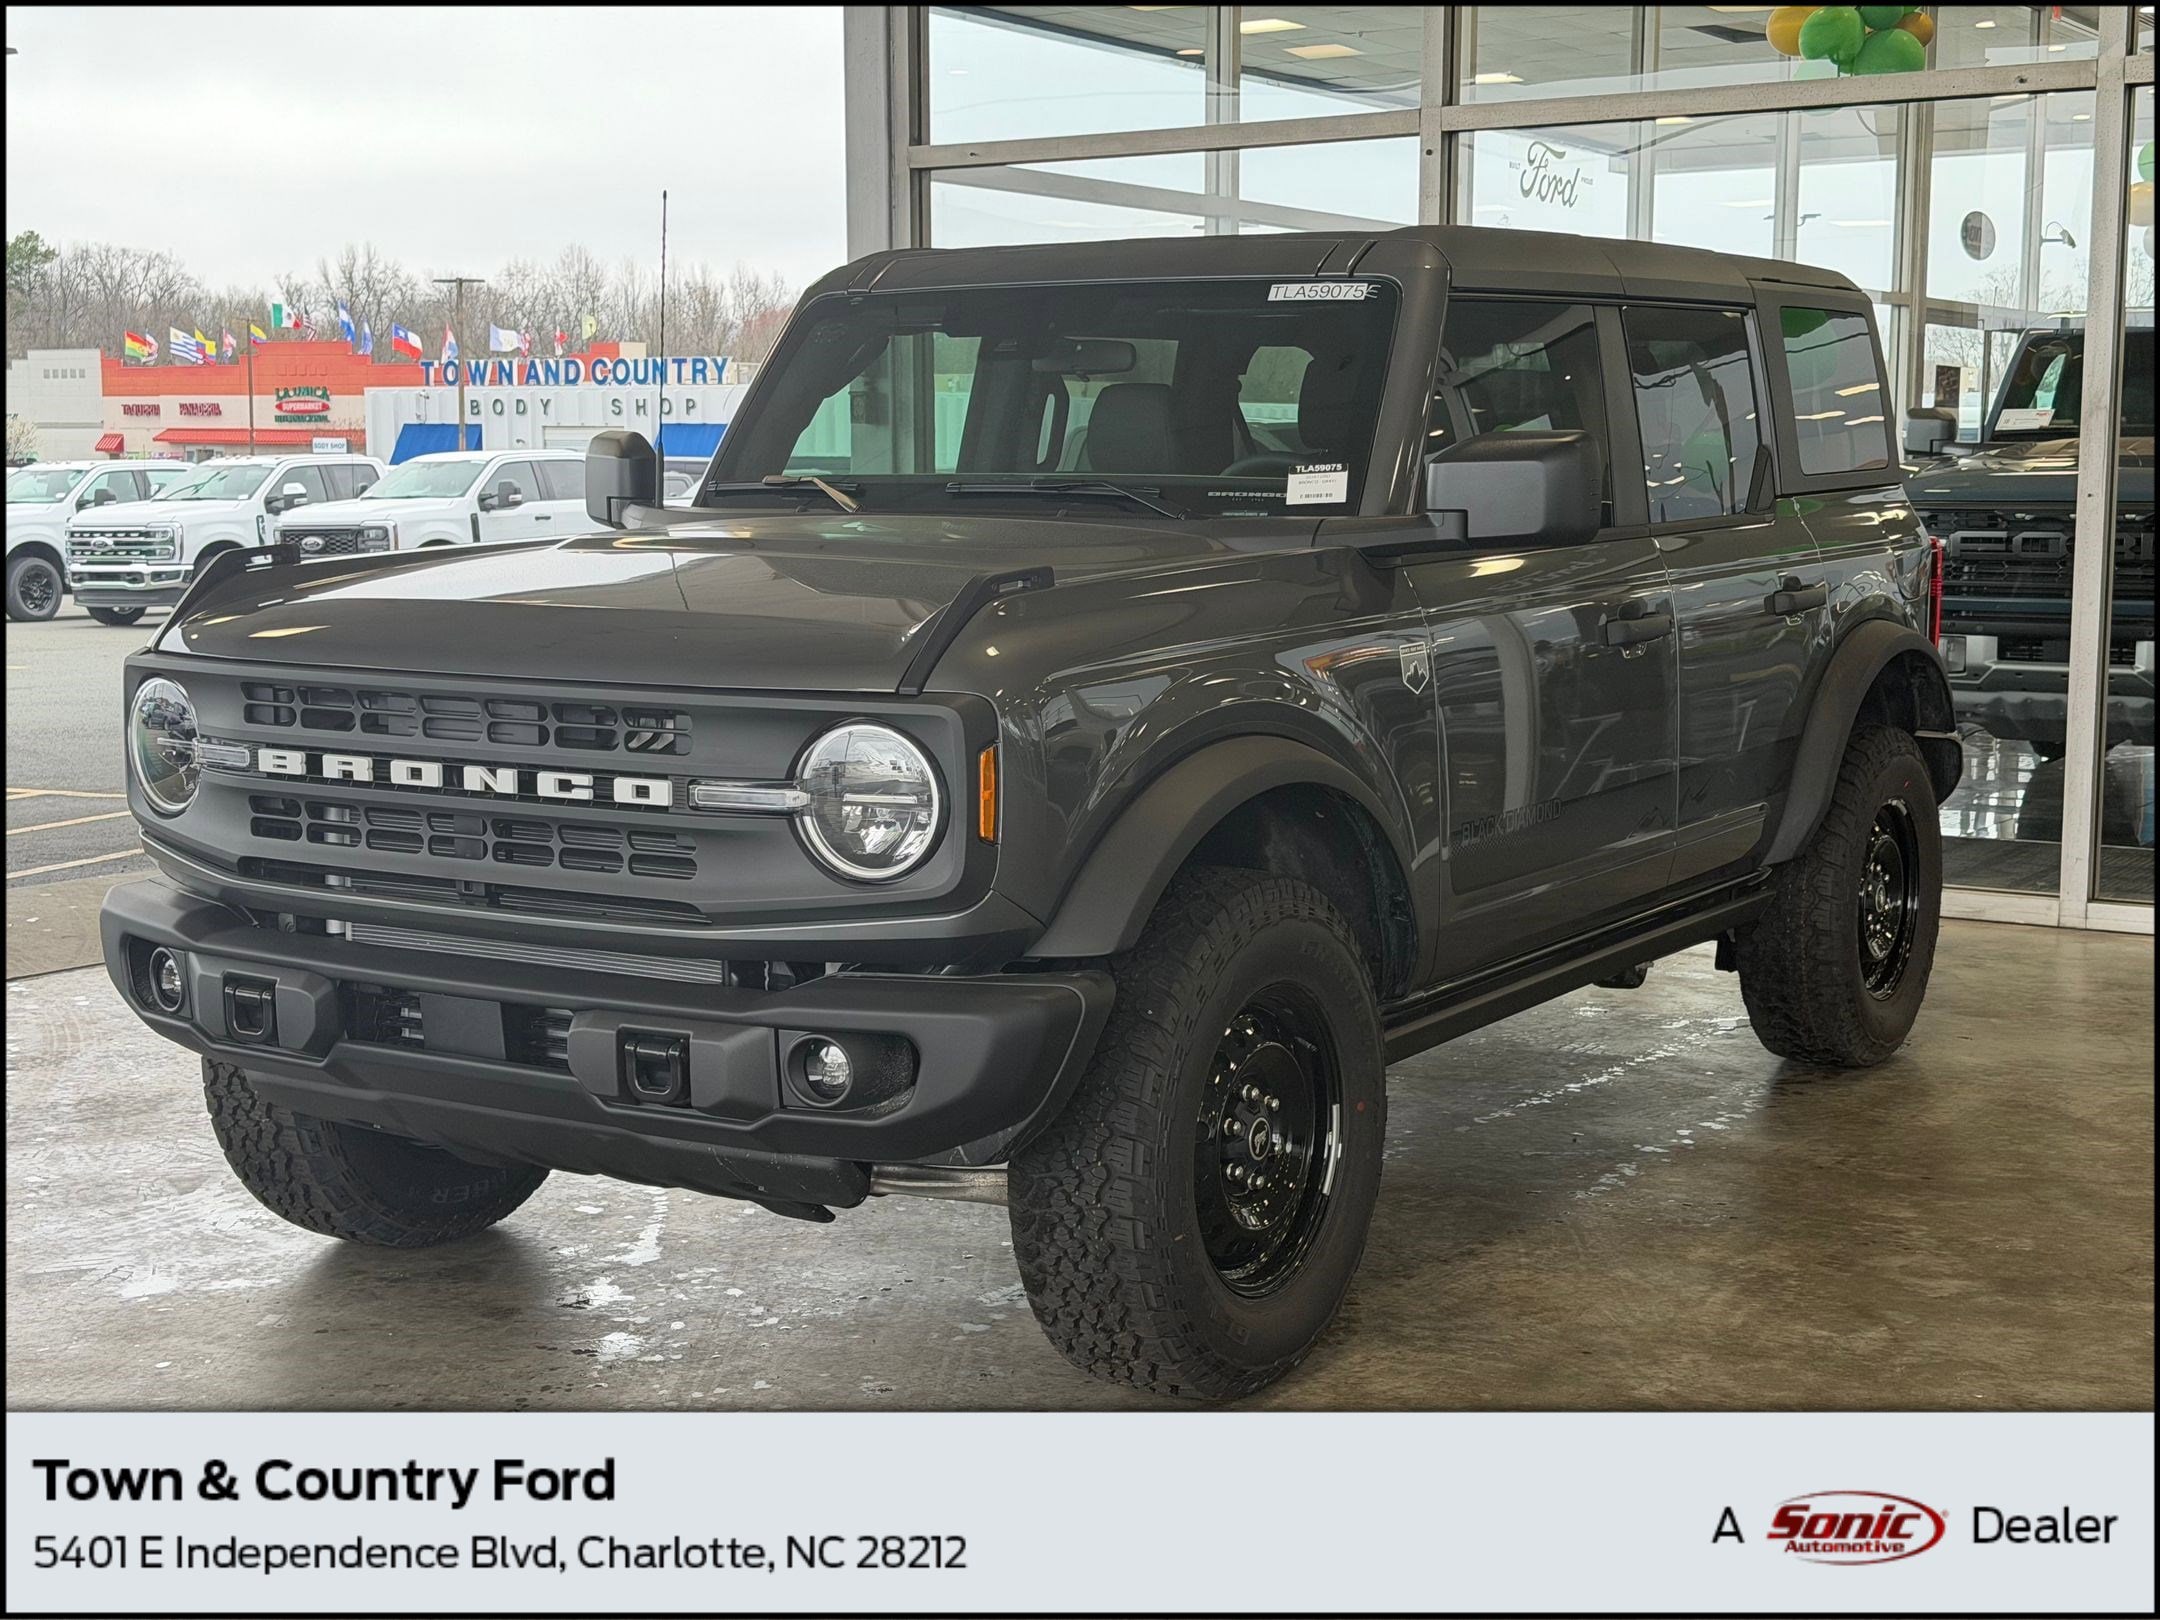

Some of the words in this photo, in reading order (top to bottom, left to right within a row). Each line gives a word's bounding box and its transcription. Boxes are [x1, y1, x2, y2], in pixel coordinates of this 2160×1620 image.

[1520, 141, 1580, 208] Ford
[1272, 285, 1365, 300] TLA59075
[420, 358, 516, 386] TOWN
[523, 358, 583, 386] AND
[590, 357, 729, 386] COUNTRY
[470, 398, 552, 416] BODY
[611, 398, 696, 416] SHOP
[1295, 463, 1343, 473] TLA59075
[258, 748, 673, 807] BRONCO
[1462, 814, 1504, 842] BLACK
[1505, 798, 1561, 834] DIAMOND
